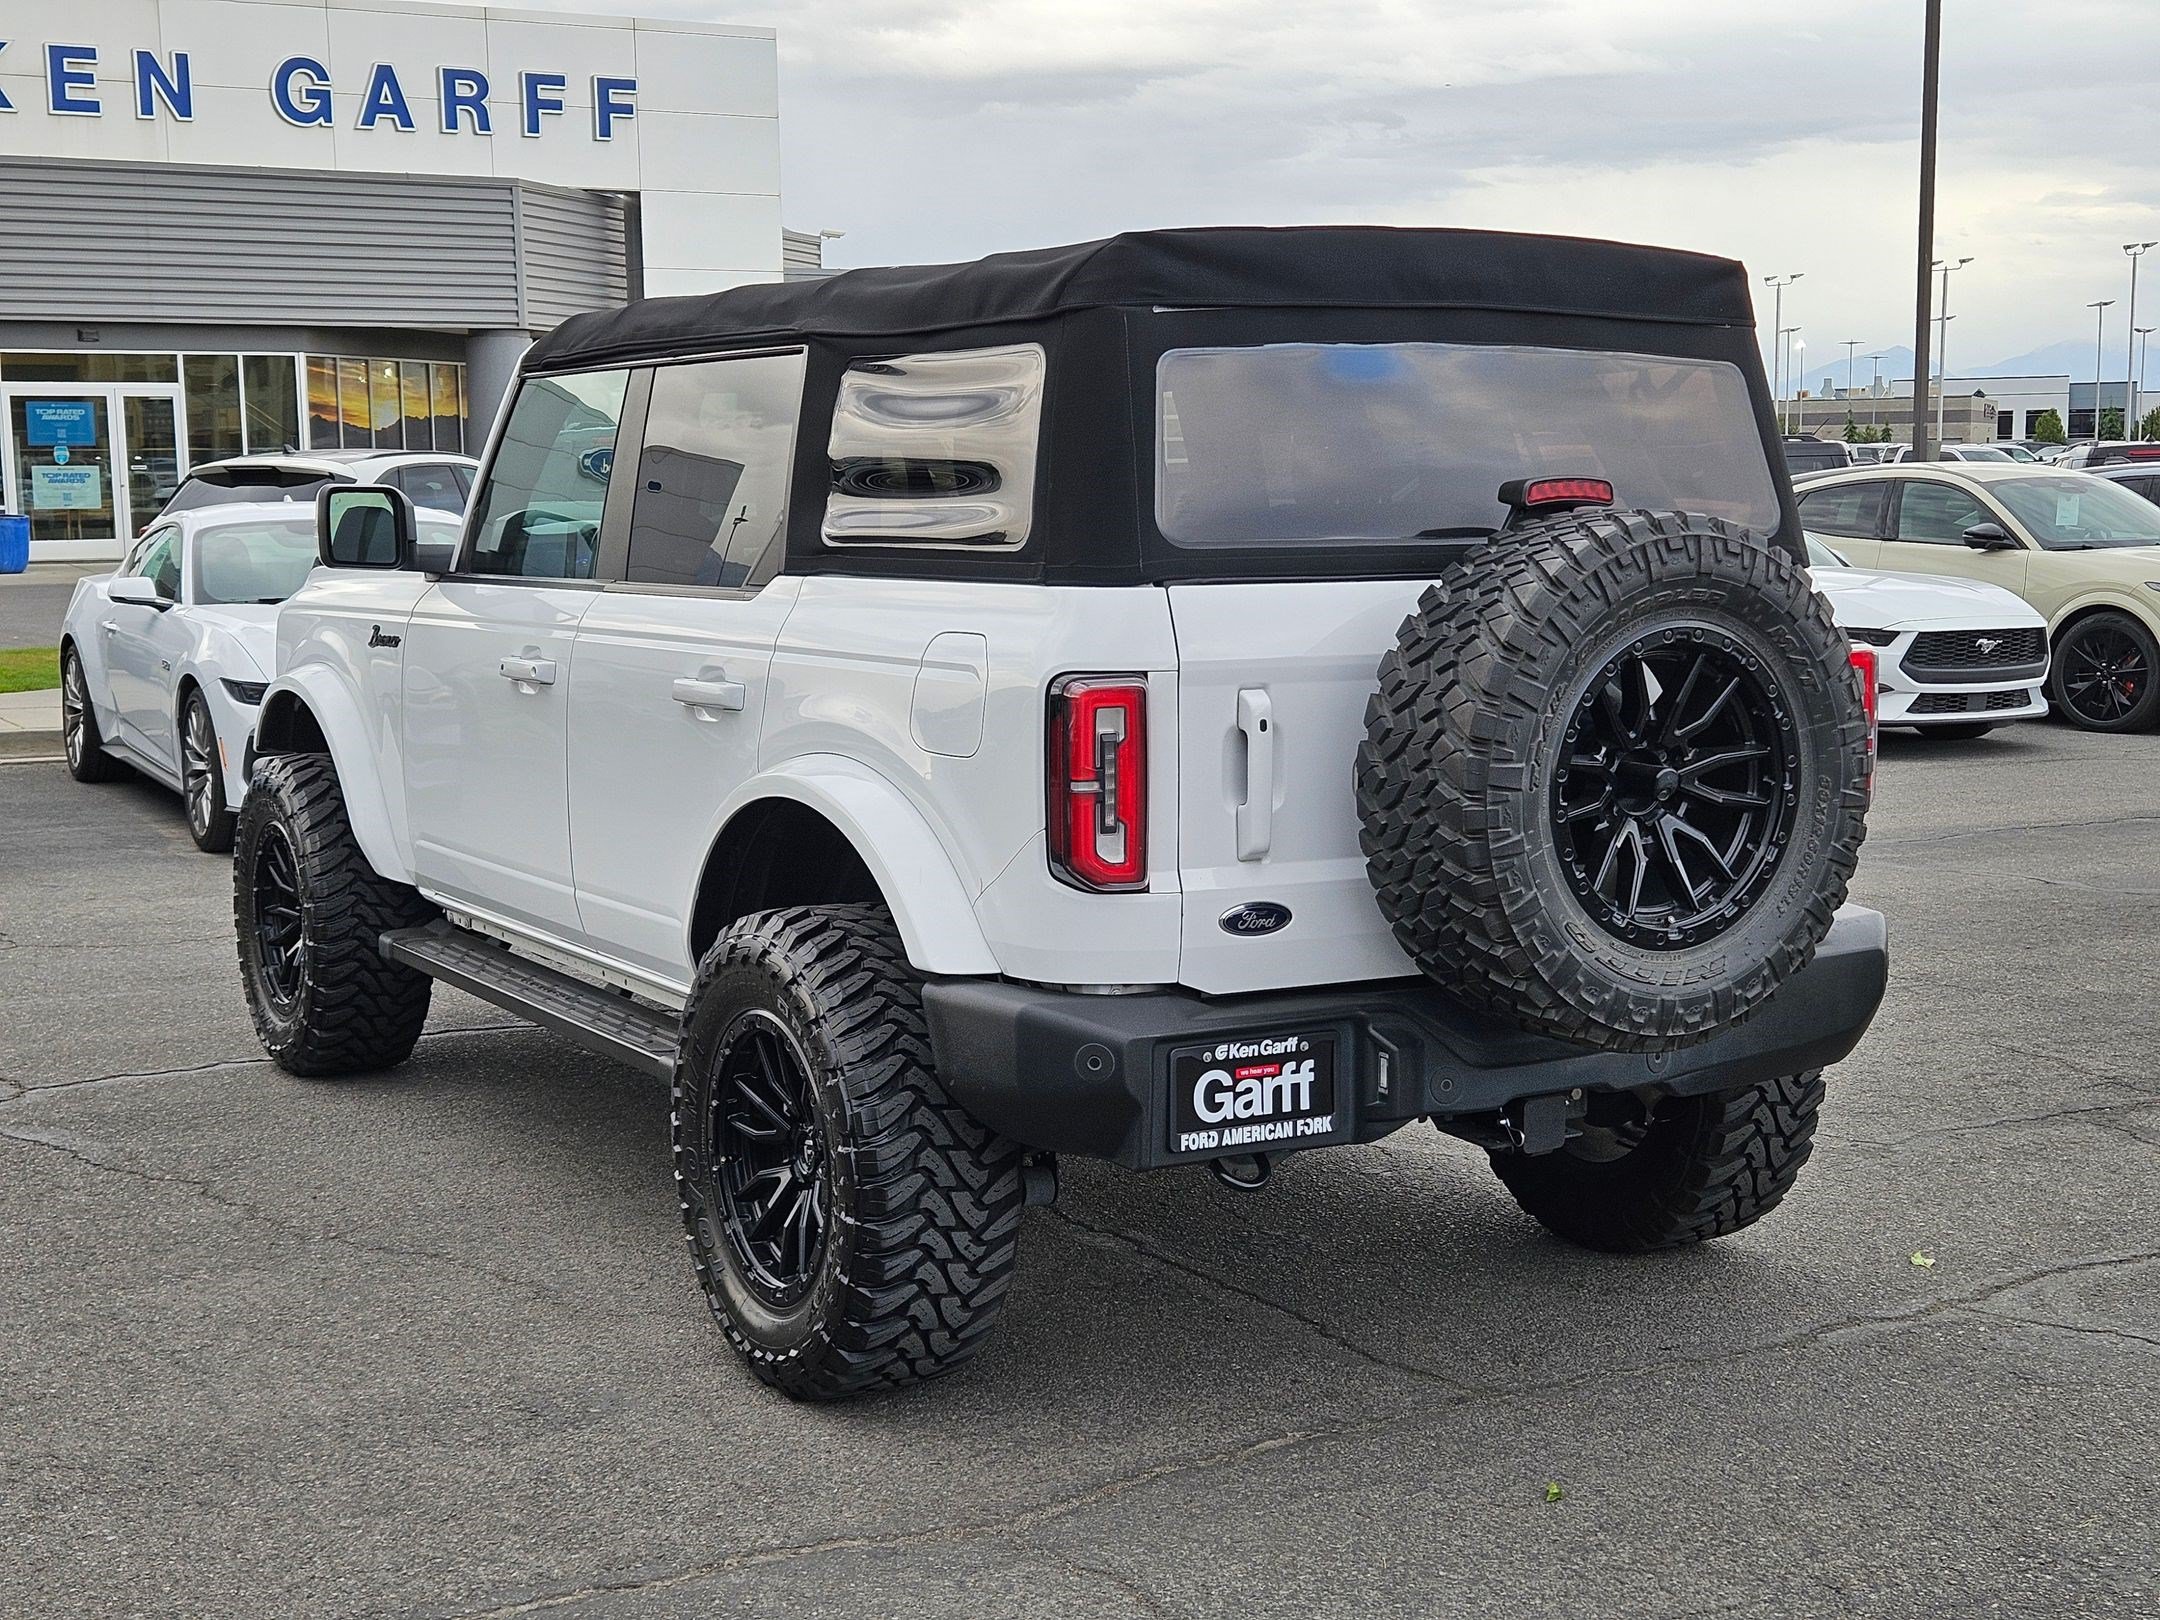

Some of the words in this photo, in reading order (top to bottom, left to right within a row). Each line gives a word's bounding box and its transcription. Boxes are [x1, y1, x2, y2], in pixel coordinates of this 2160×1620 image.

[0, 39, 194, 121] EN
[272, 54, 638, 142] GARFF
[368, 624, 402, 649] Bronco
[1238, 910, 1277, 930] Ford
[1565, 921, 1727, 986] NITTO
[1228, 1042, 1258, 1060] Ken
[1260, 1036, 1298, 1056] Garff
[1250, 1067, 1263, 1075] hear
[1264, 1066, 1275, 1074] you
[1193, 1059, 1315, 1123] Garff
[1181, 1131, 1218, 1152] FORD
[1222, 1121, 1293, 1147] AMERICAN
[1297, 1116, 1333, 1137] FORK
